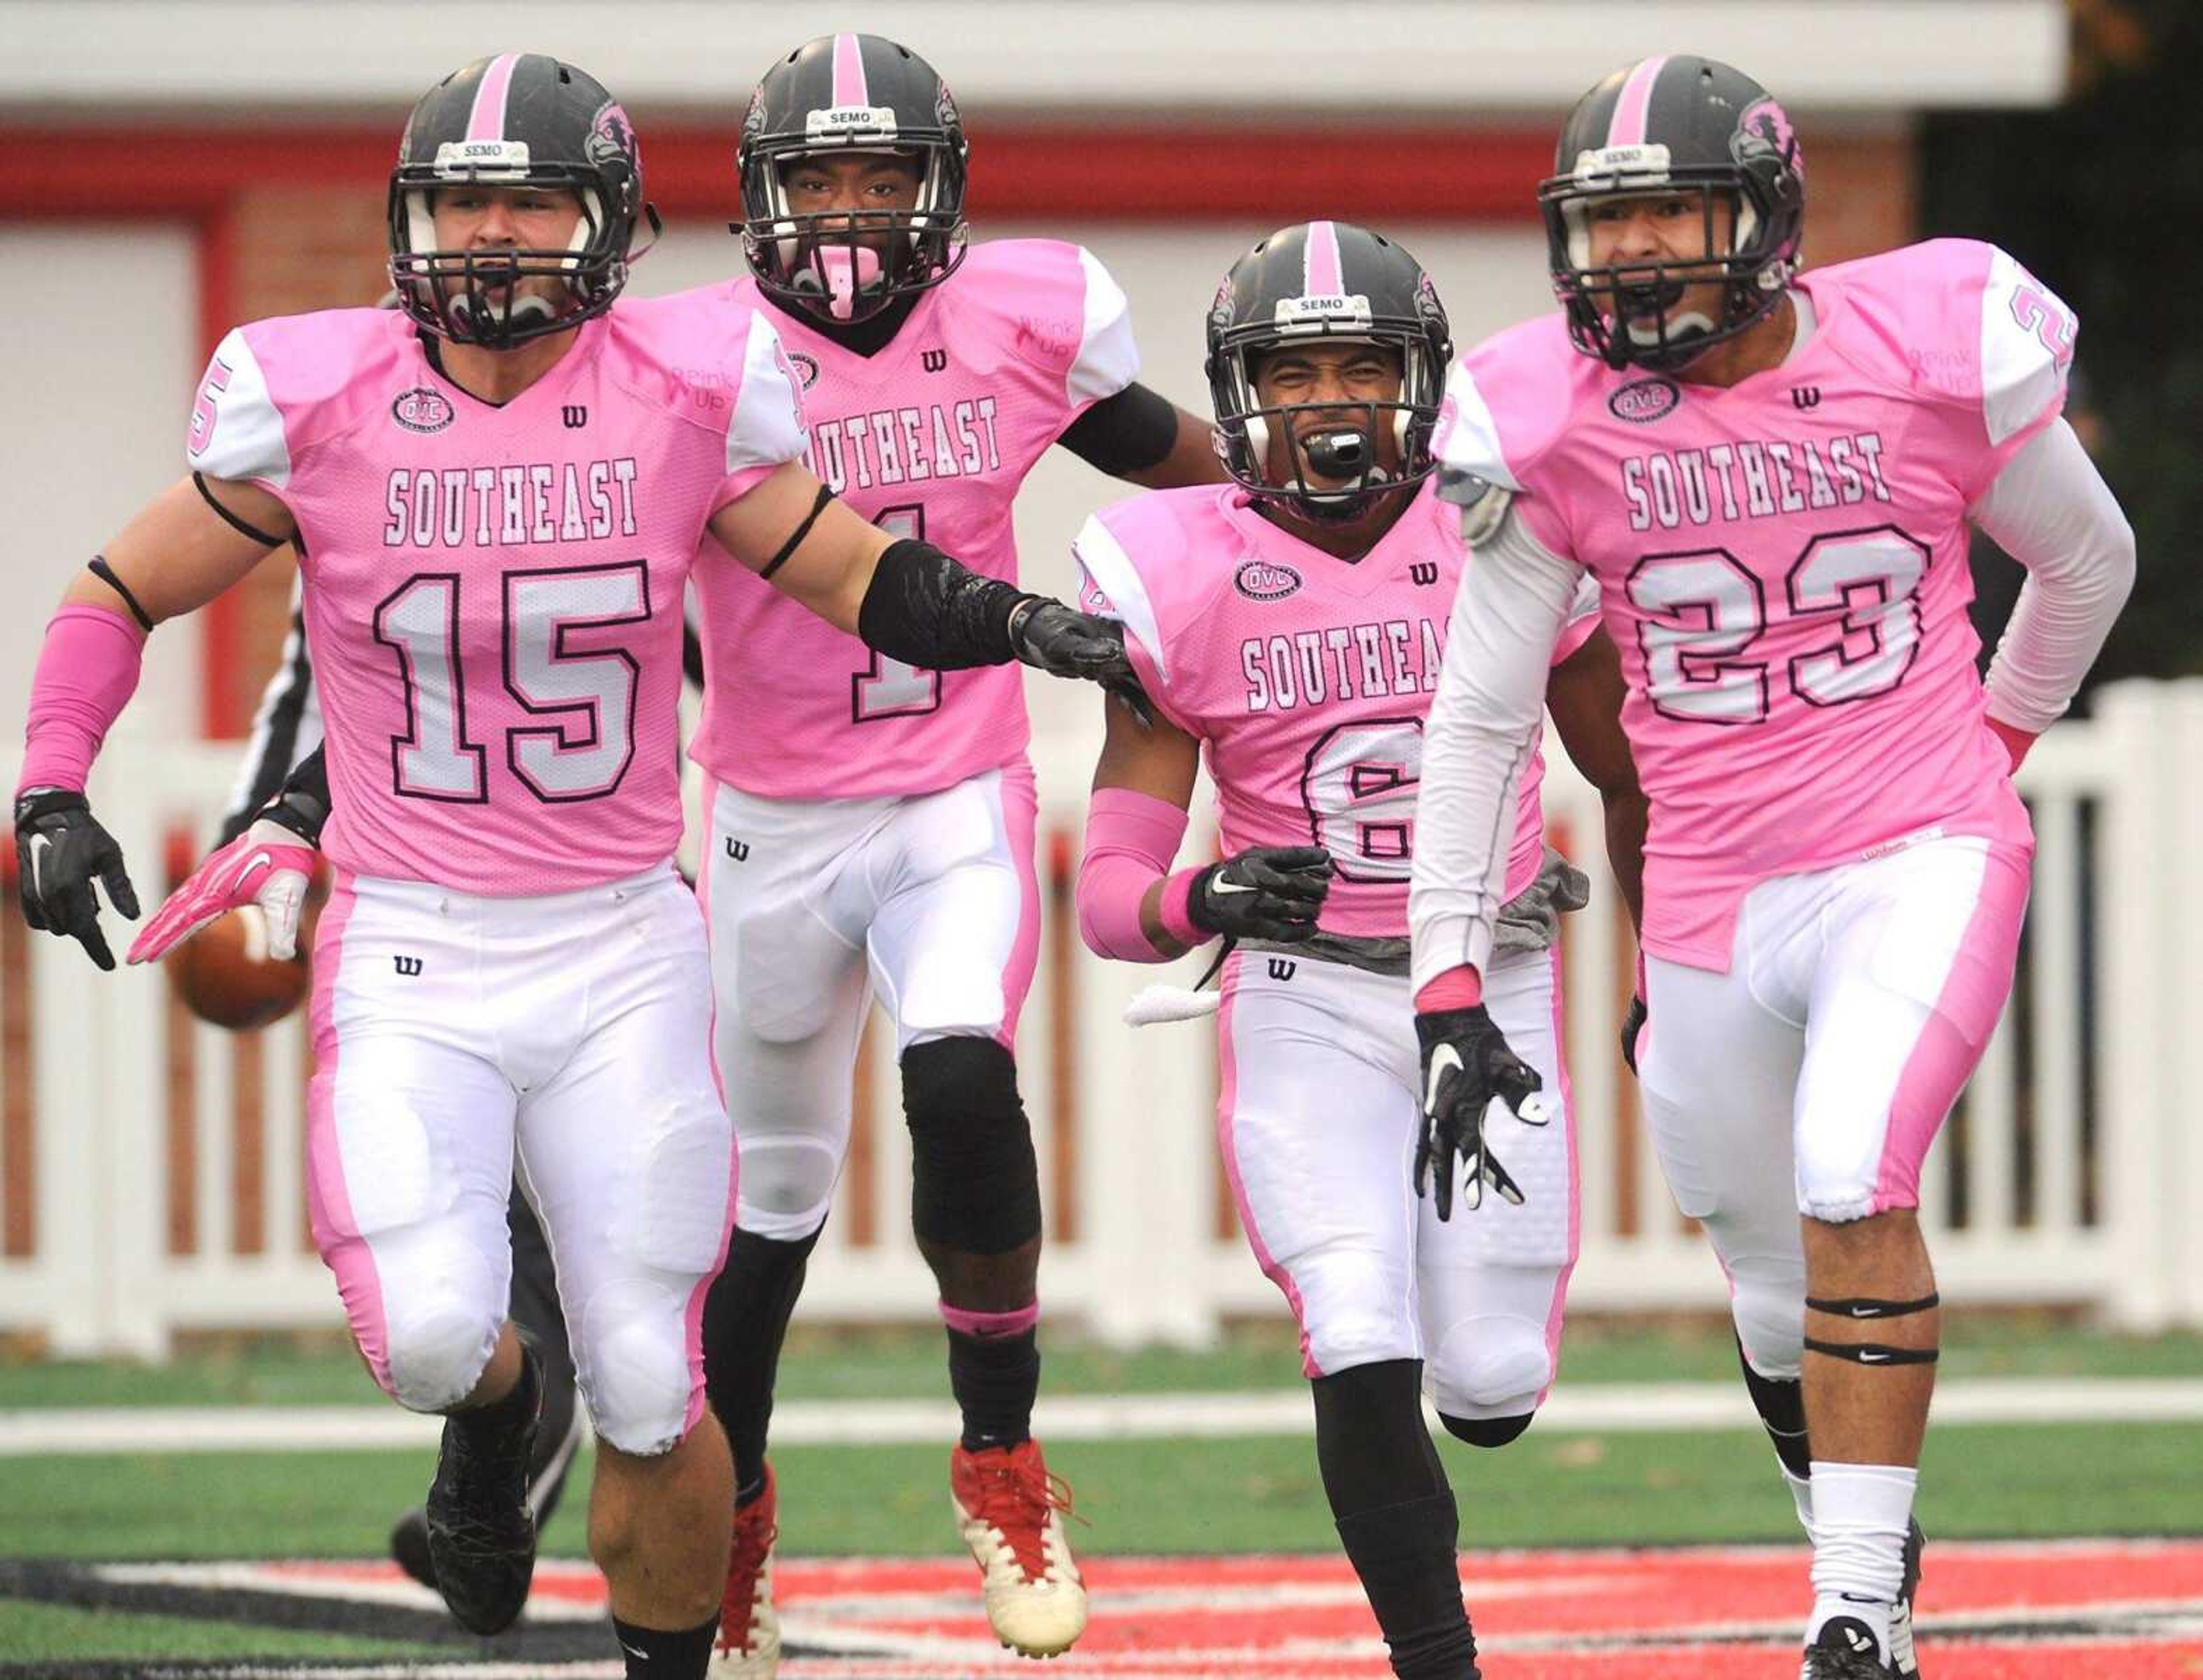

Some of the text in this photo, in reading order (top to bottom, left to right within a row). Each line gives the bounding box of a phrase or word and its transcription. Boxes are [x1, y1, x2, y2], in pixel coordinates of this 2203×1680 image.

[464, 145, 502, 157] SEMO
[830, 112, 871, 124] SEMO
[1300, 299, 1344, 311] SEMO
[803, 396, 1000, 495] UTHEAST
[1620, 432, 1891, 531] SOUTHEAST
[384, 457, 638, 547] SOUTHEAST
[1240, 615, 1452, 713] SOUTHEA
[1625, 522, 1932, 726] 23
[372, 559, 652, 804] 15
